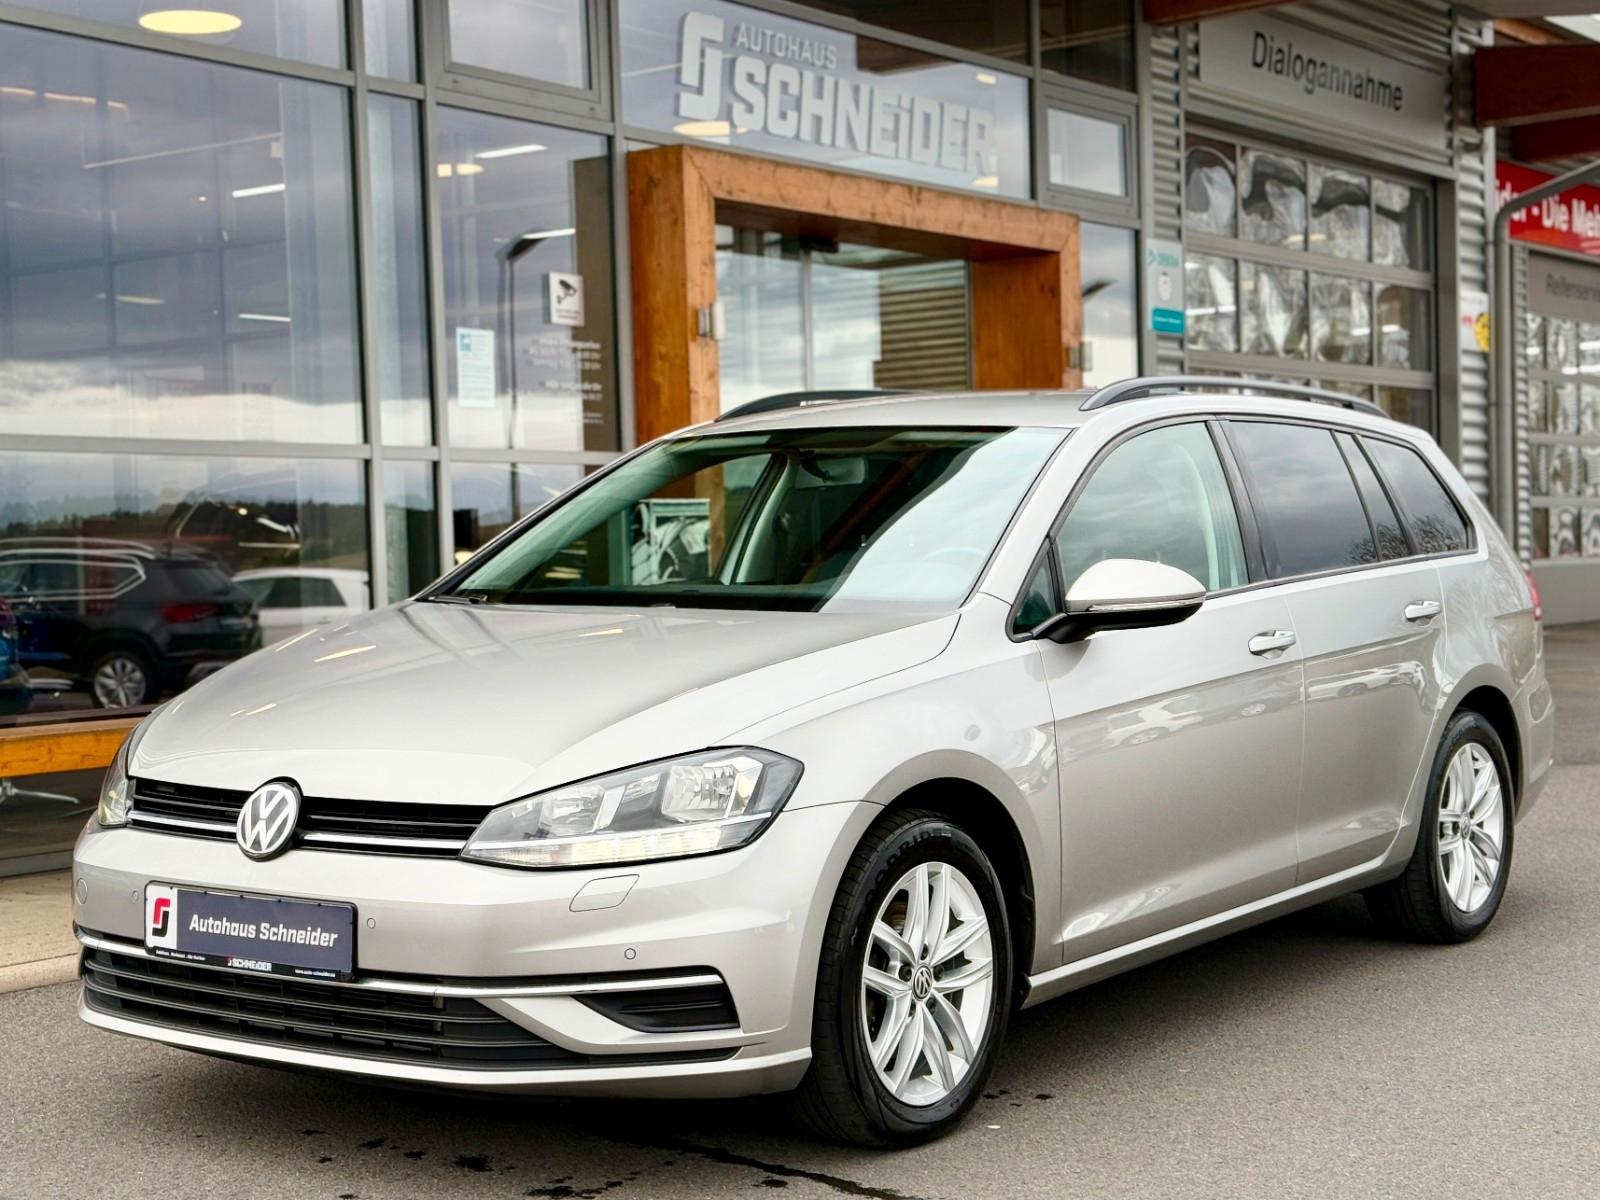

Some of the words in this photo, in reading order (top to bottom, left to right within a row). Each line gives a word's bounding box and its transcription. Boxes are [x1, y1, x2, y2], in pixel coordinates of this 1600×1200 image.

[736, 23, 838, 70] AUTOHAUS
[1252, 30, 1403, 112] Dialogannahme
[1541, 193, 1570, 233] Die
[188, 913, 257, 939] Autohaus
[259, 922, 338, 948] Schneider
